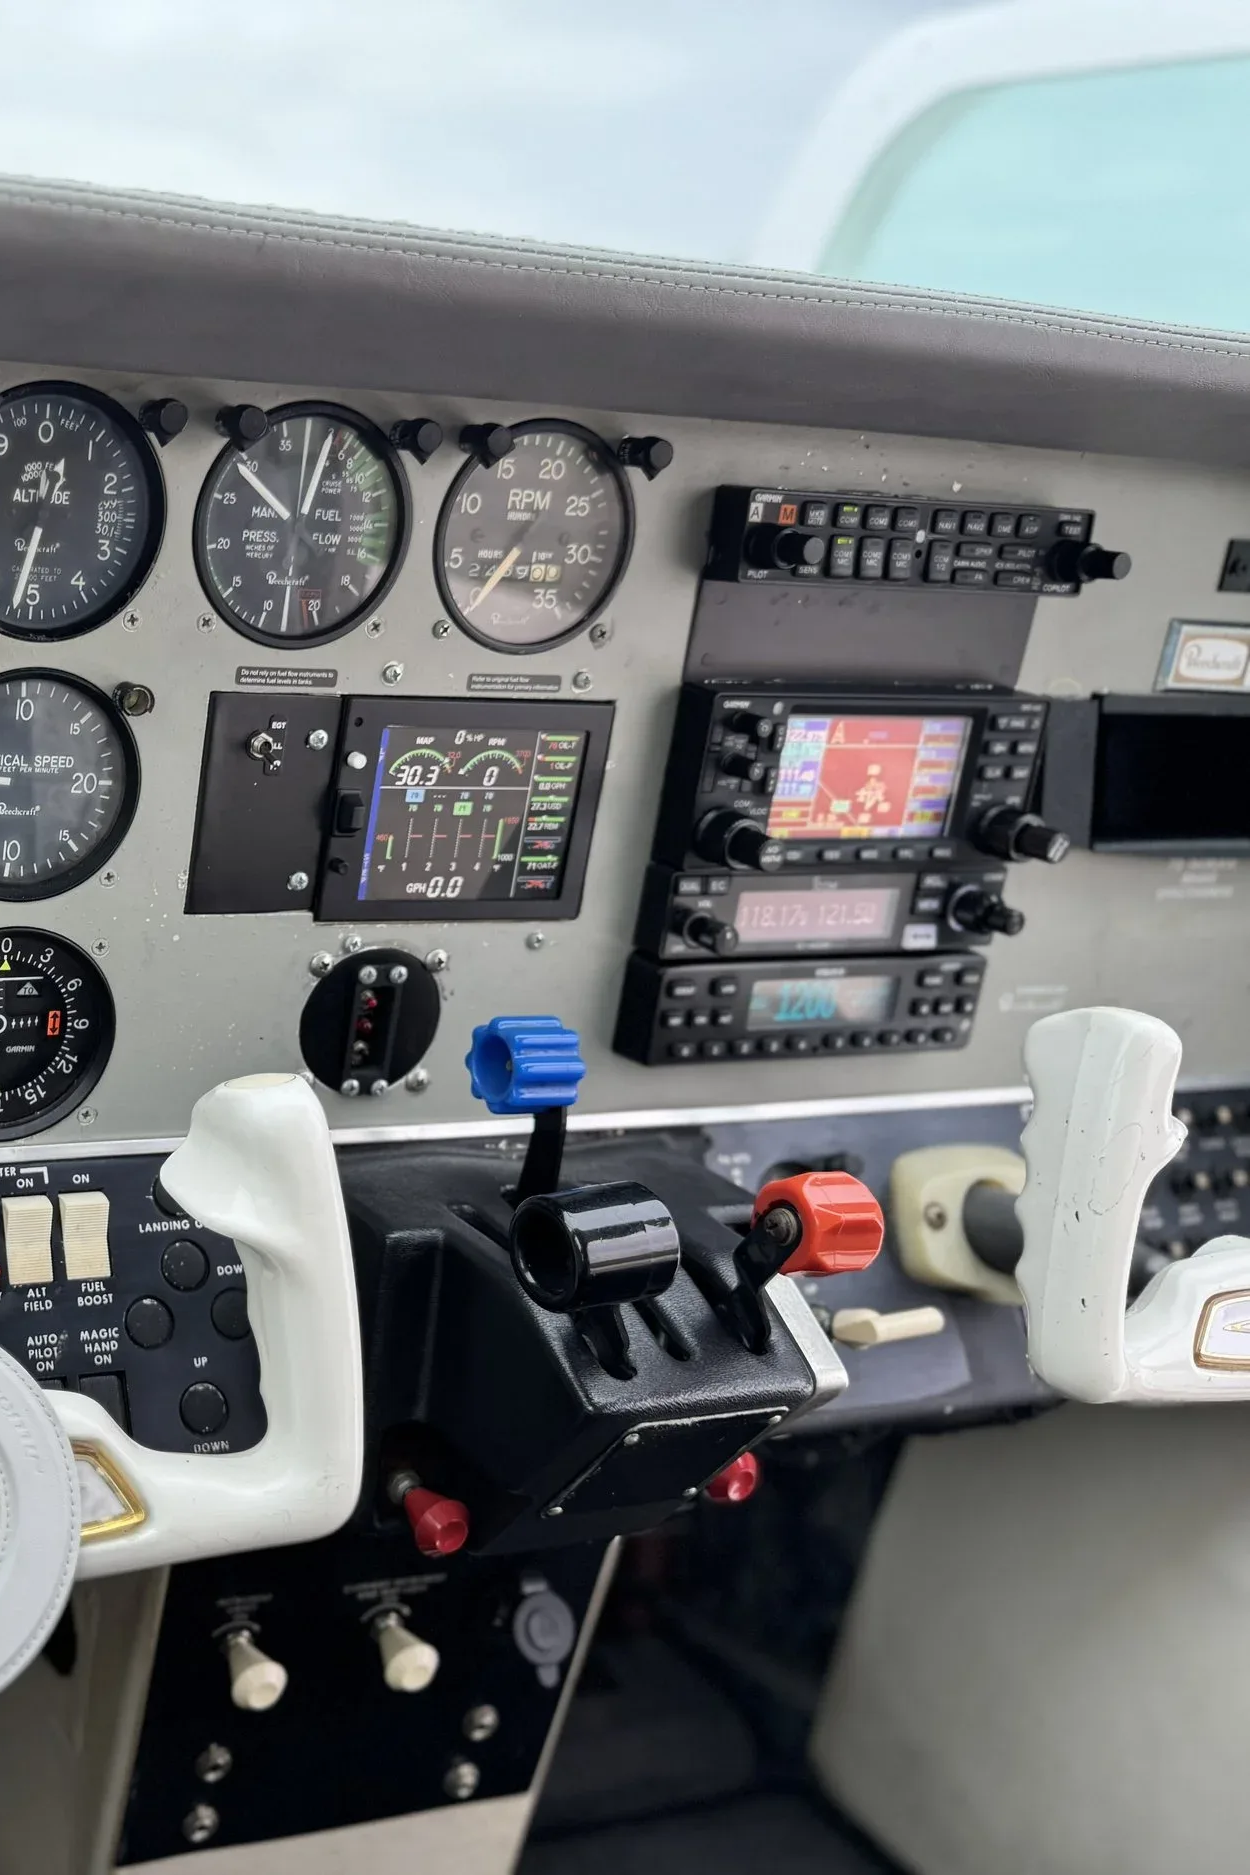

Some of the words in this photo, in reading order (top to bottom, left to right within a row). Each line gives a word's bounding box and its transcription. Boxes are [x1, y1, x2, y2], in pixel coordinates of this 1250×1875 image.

[14, 418, 26, 427] 100
[60, 419, 79, 431] FEET
[38, 421, 54, 443] 0
[539, 461, 565, 480] 20
[104, 473, 117, 494] 2
[508, 489, 551, 511] RPM
[755, 494, 783, 502] GARMIN
[252, 507, 278, 518] MAN.
[565, 496, 590, 517] 25
[752, 504, 759, 518] A
[315, 510, 342, 520] FUEL
[783, 509, 793, 519] M
[242, 531, 279, 542] PRESS.
[267, 572, 306, 585] Beechcraft
[533, 589, 556, 609] 35
[16, 699, 34, 720] 10
[489, 738, 507, 746] RPM
[35, 756, 74, 768] SPEED
[395, 766, 439, 785] 30.3
[71, 773, 97, 793] 20
[406, 883, 426, 893] GPH
[427, 876, 463, 897] 0.0
[6, 1045, 35, 1053] GARMIN
[16, 1178, 34, 1188] ON
[73, 1173, 89, 1184] ON
[139, 1219, 190, 1234] LANDING
[27, 1287, 47, 1299] ALT
[81, 1281, 106, 1293] FUEL
[24, 1300, 53, 1312] FIELD
[78, 1293, 113, 1307] BOOST
[27, 1335, 58, 1346] AUTO
[80, 1328, 120, 1341] MAGIC
[84, 1340, 118, 1352] HAND
[28, 1347, 58, 1359] PILOT
[36, 1360, 54, 1372] ON
[94, 1354, 112, 1366] ON
[194, 1356, 208, 1368] UP
[194, 1440, 230, 1454] DOWN
